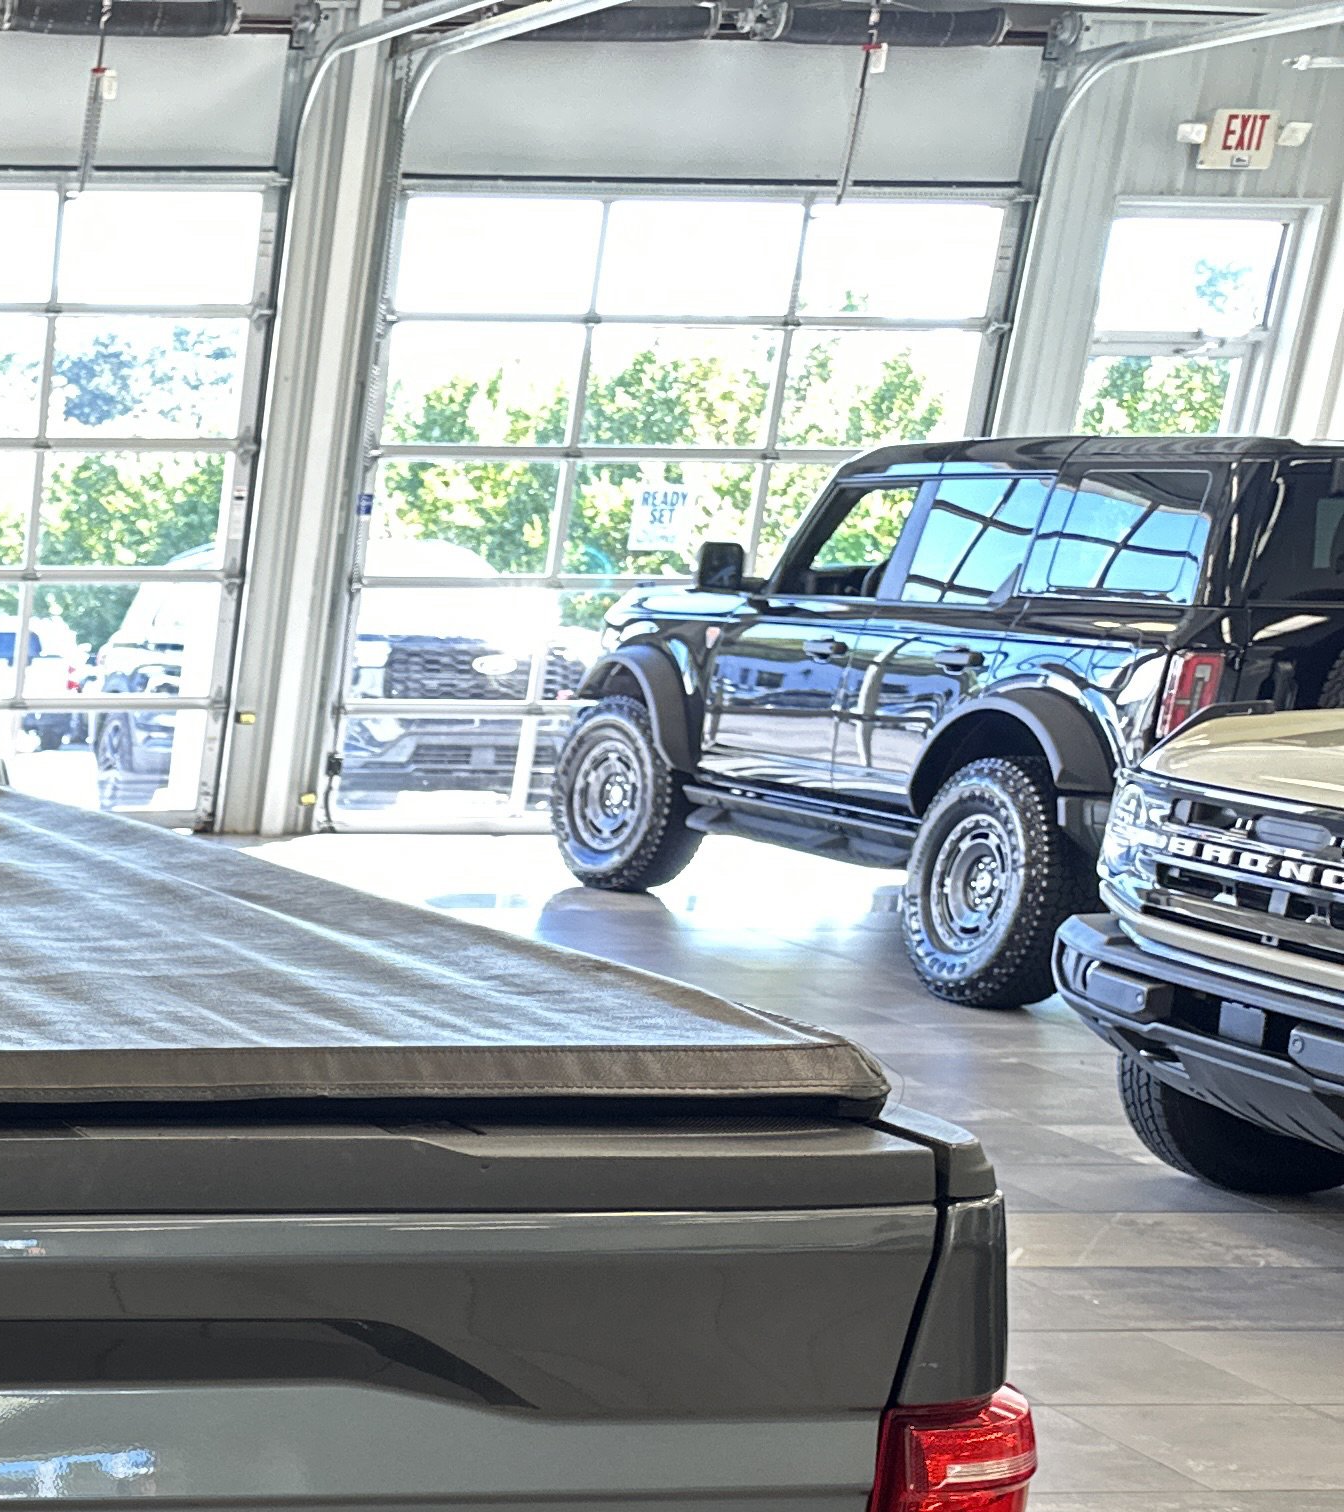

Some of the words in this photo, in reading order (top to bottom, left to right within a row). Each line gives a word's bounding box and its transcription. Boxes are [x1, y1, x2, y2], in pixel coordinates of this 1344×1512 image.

[1221, 114, 1271, 151] EXIT
[642, 491, 688, 506] READY
[649, 508, 675, 524] SET
